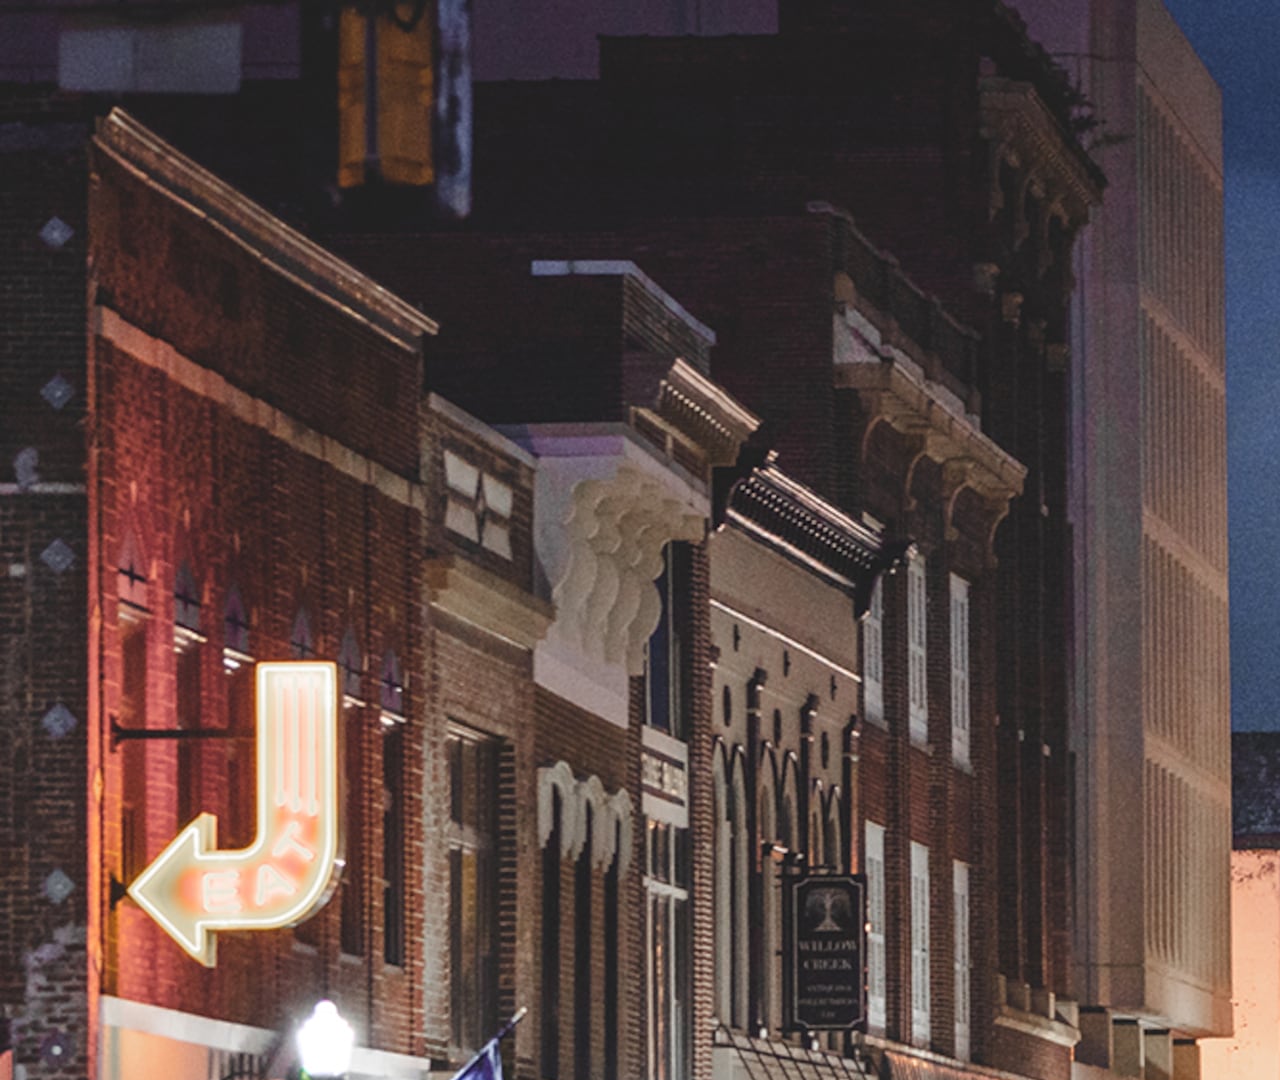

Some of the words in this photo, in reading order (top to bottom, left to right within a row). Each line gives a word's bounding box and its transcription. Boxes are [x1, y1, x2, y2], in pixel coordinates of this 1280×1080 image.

[201, 820, 315, 914] EAT
[799, 939, 858, 952] WILLOW
[803, 958, 853, 971] CREEK
